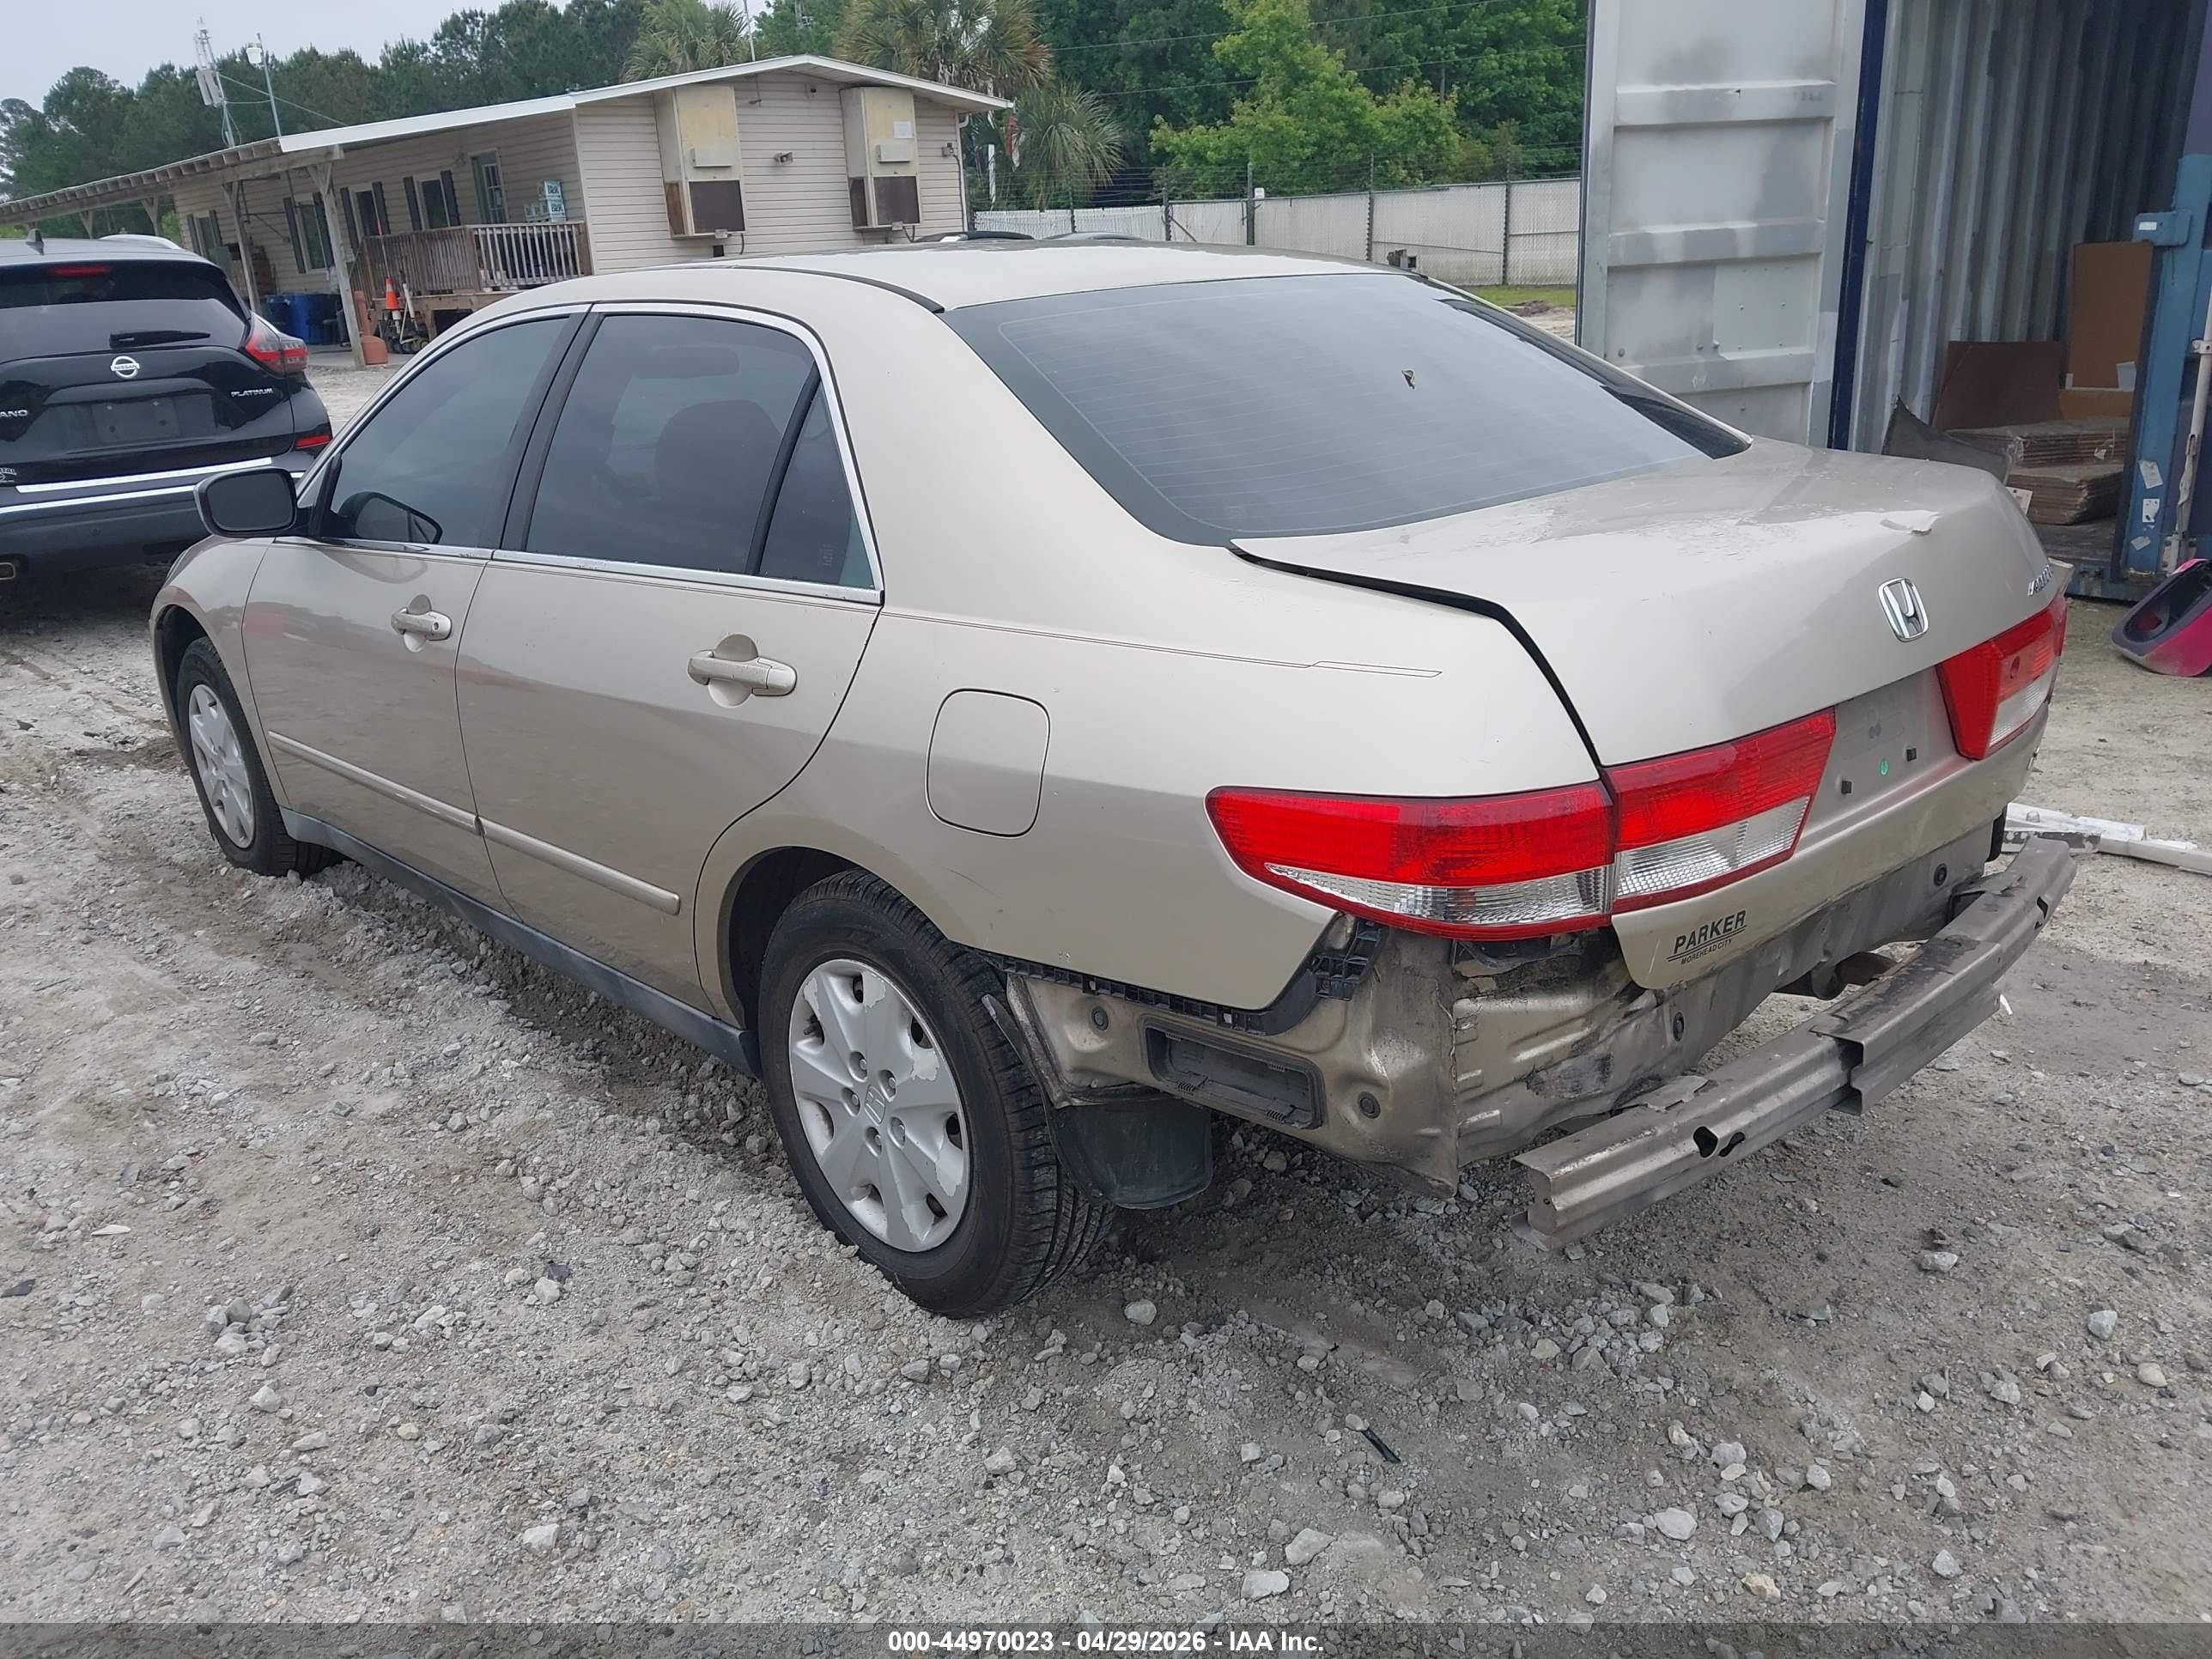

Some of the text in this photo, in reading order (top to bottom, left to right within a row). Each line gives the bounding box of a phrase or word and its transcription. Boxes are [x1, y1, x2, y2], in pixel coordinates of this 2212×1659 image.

[230, 387, 274, 398] PLATINUM
[1673, 909, 1747, 954] PARKER
[1680, 945, 1717, 964] MOREHEAD
